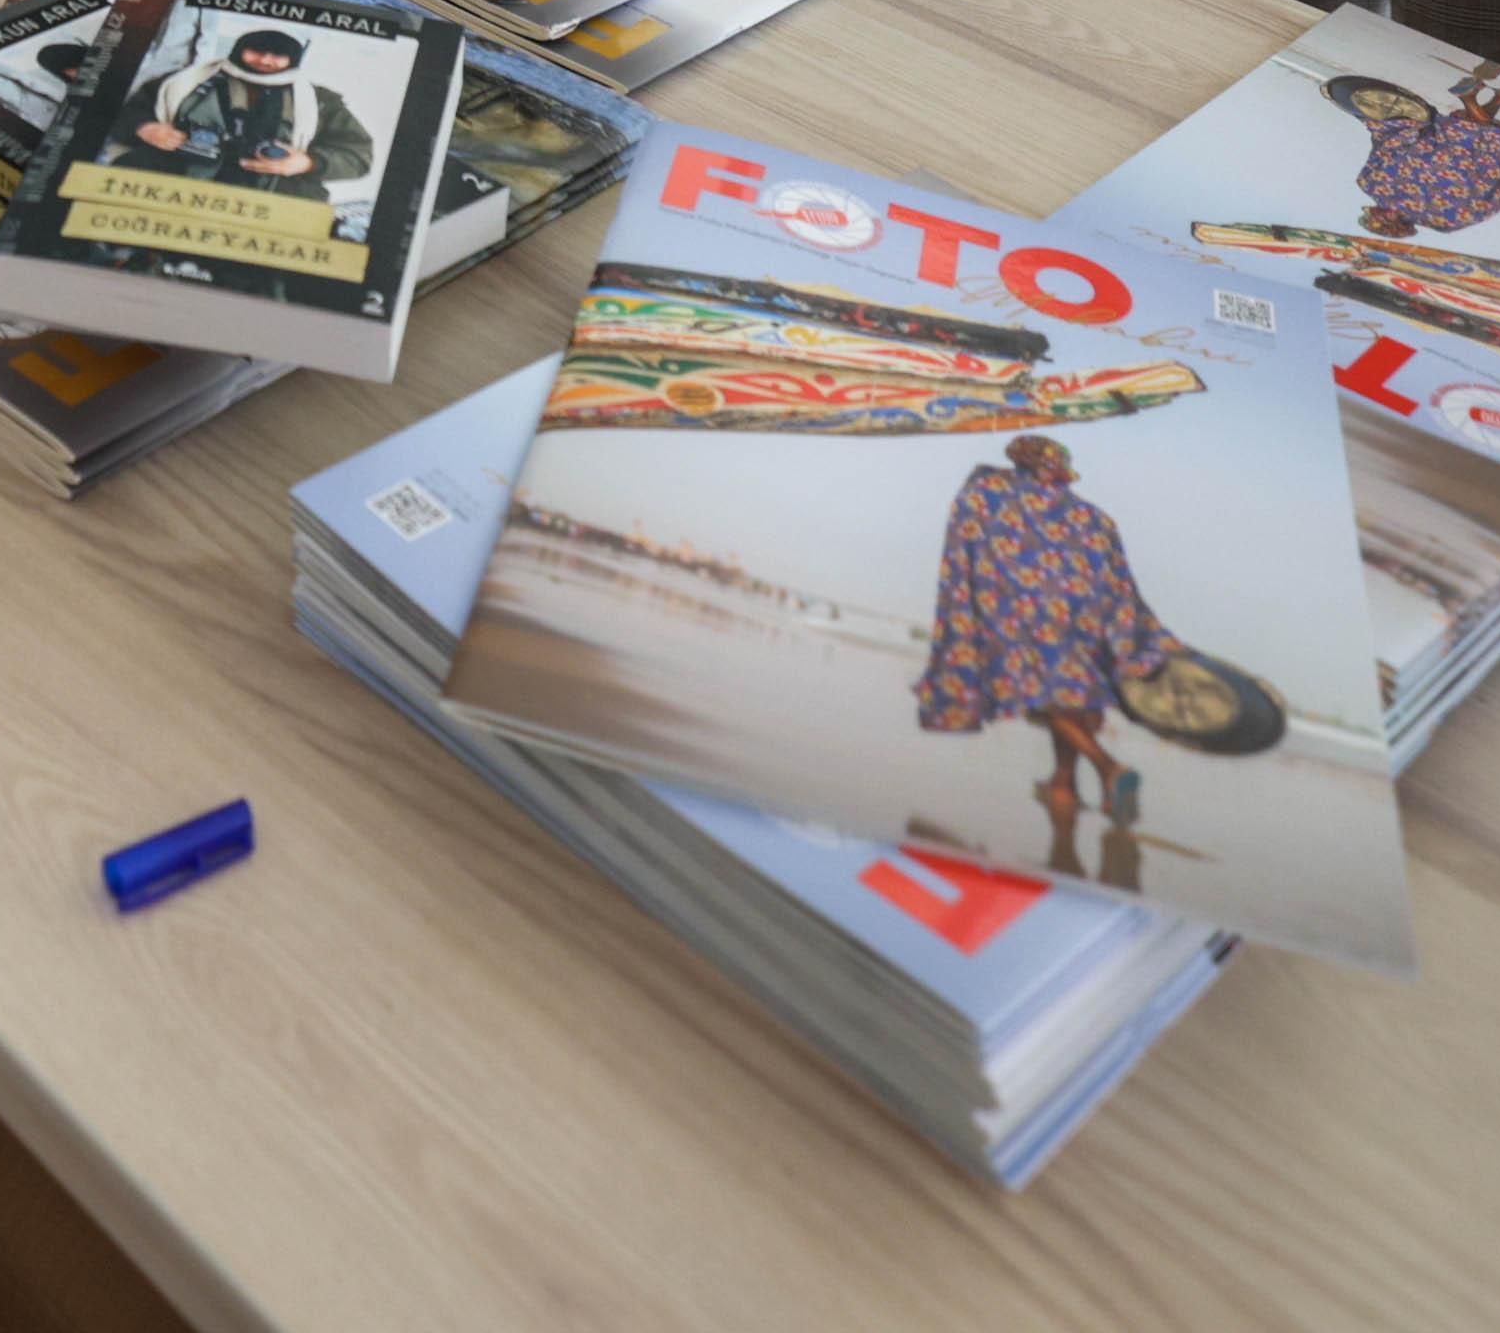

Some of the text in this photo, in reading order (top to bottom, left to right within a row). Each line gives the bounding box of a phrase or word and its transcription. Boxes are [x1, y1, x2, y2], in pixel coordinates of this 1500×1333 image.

[314, 10, 390, 37] ARAL
[90, 206, 334, 266] COĞRAFYALAR
[361, 290, 385, 317] 2
